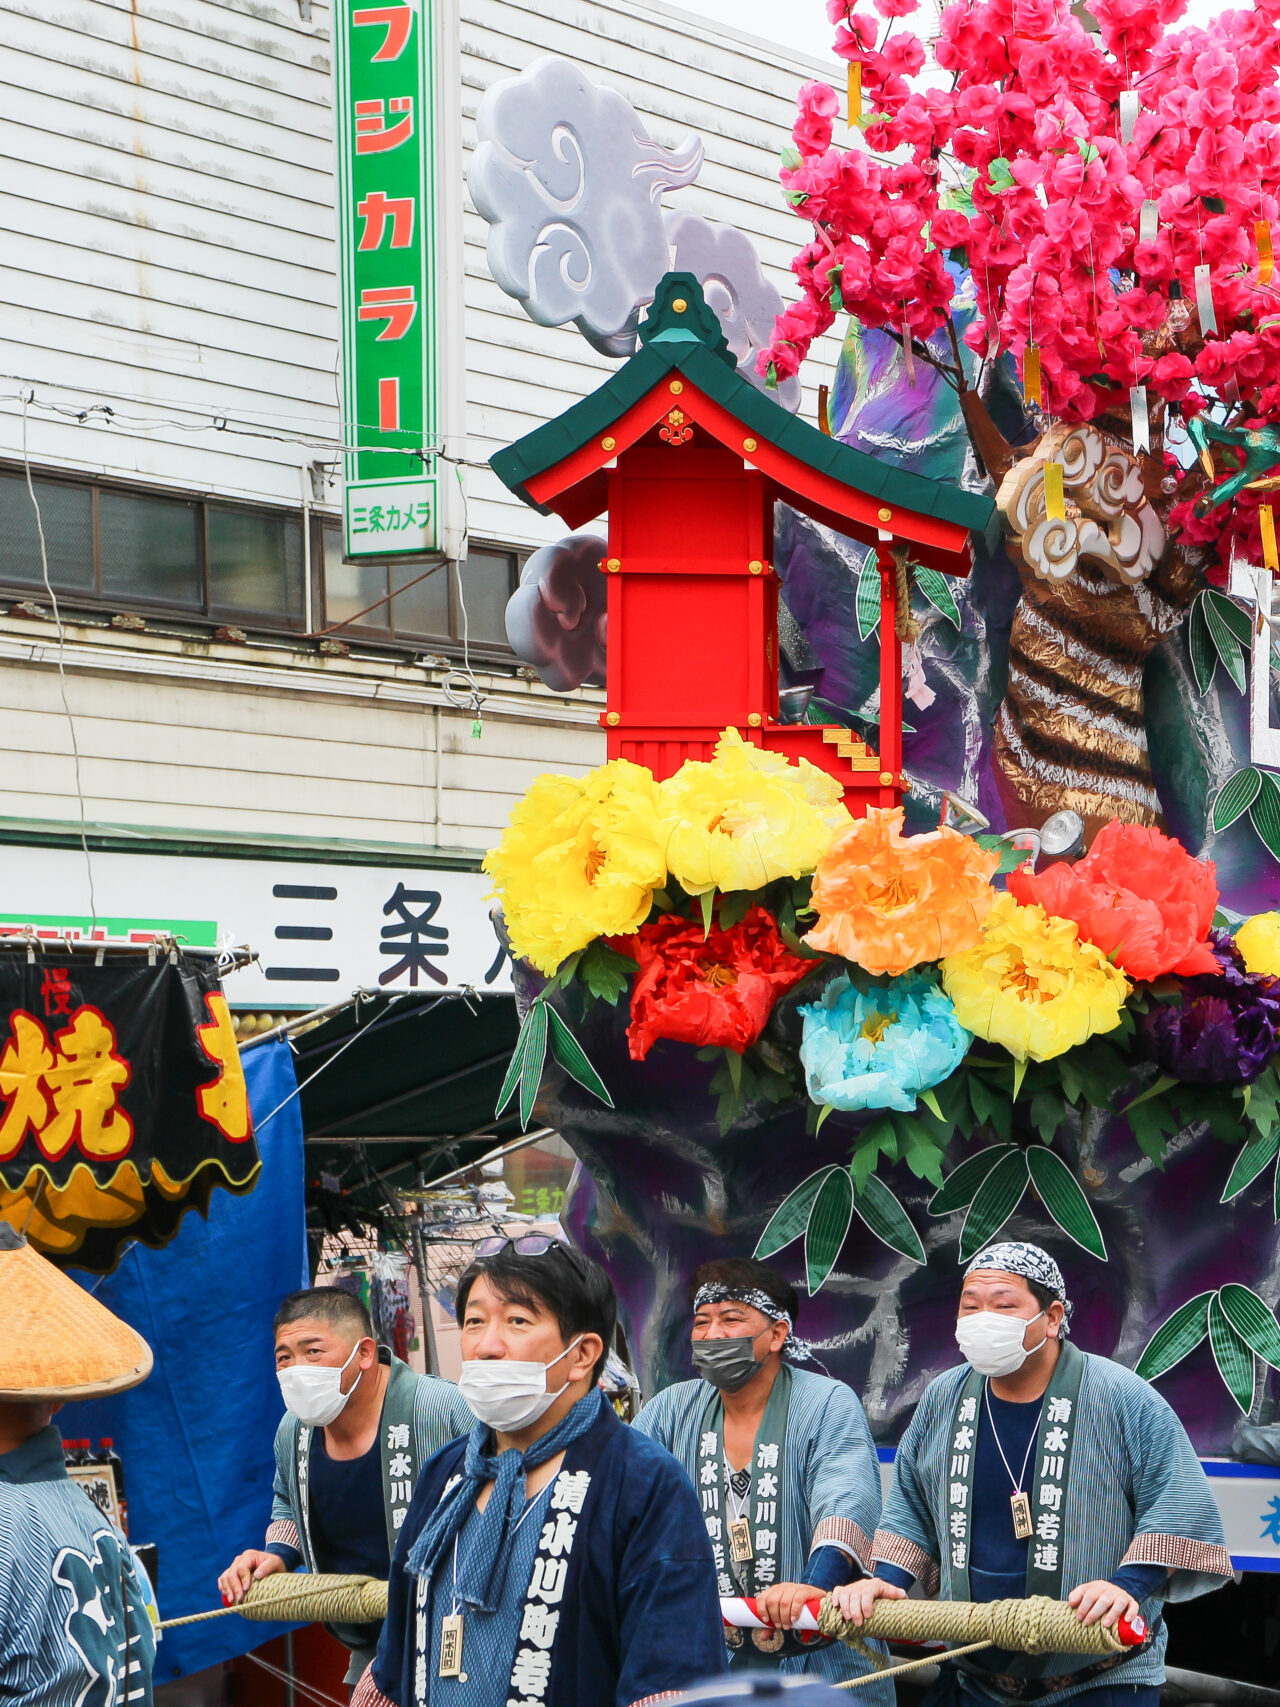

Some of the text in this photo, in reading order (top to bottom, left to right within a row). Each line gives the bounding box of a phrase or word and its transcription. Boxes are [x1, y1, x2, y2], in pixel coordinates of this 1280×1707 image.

[353, 6, 418, 434] フジカラー
[353, 501, 431, 534] 三条カメラ
[265, 881, 513, 986] 三条
[950, 1397, 977, 1570] 清水川町若連
[1034, 1397, 1073, 1572] 清水川町若連
[506, 1470, 592, 1707] 清水川町若
